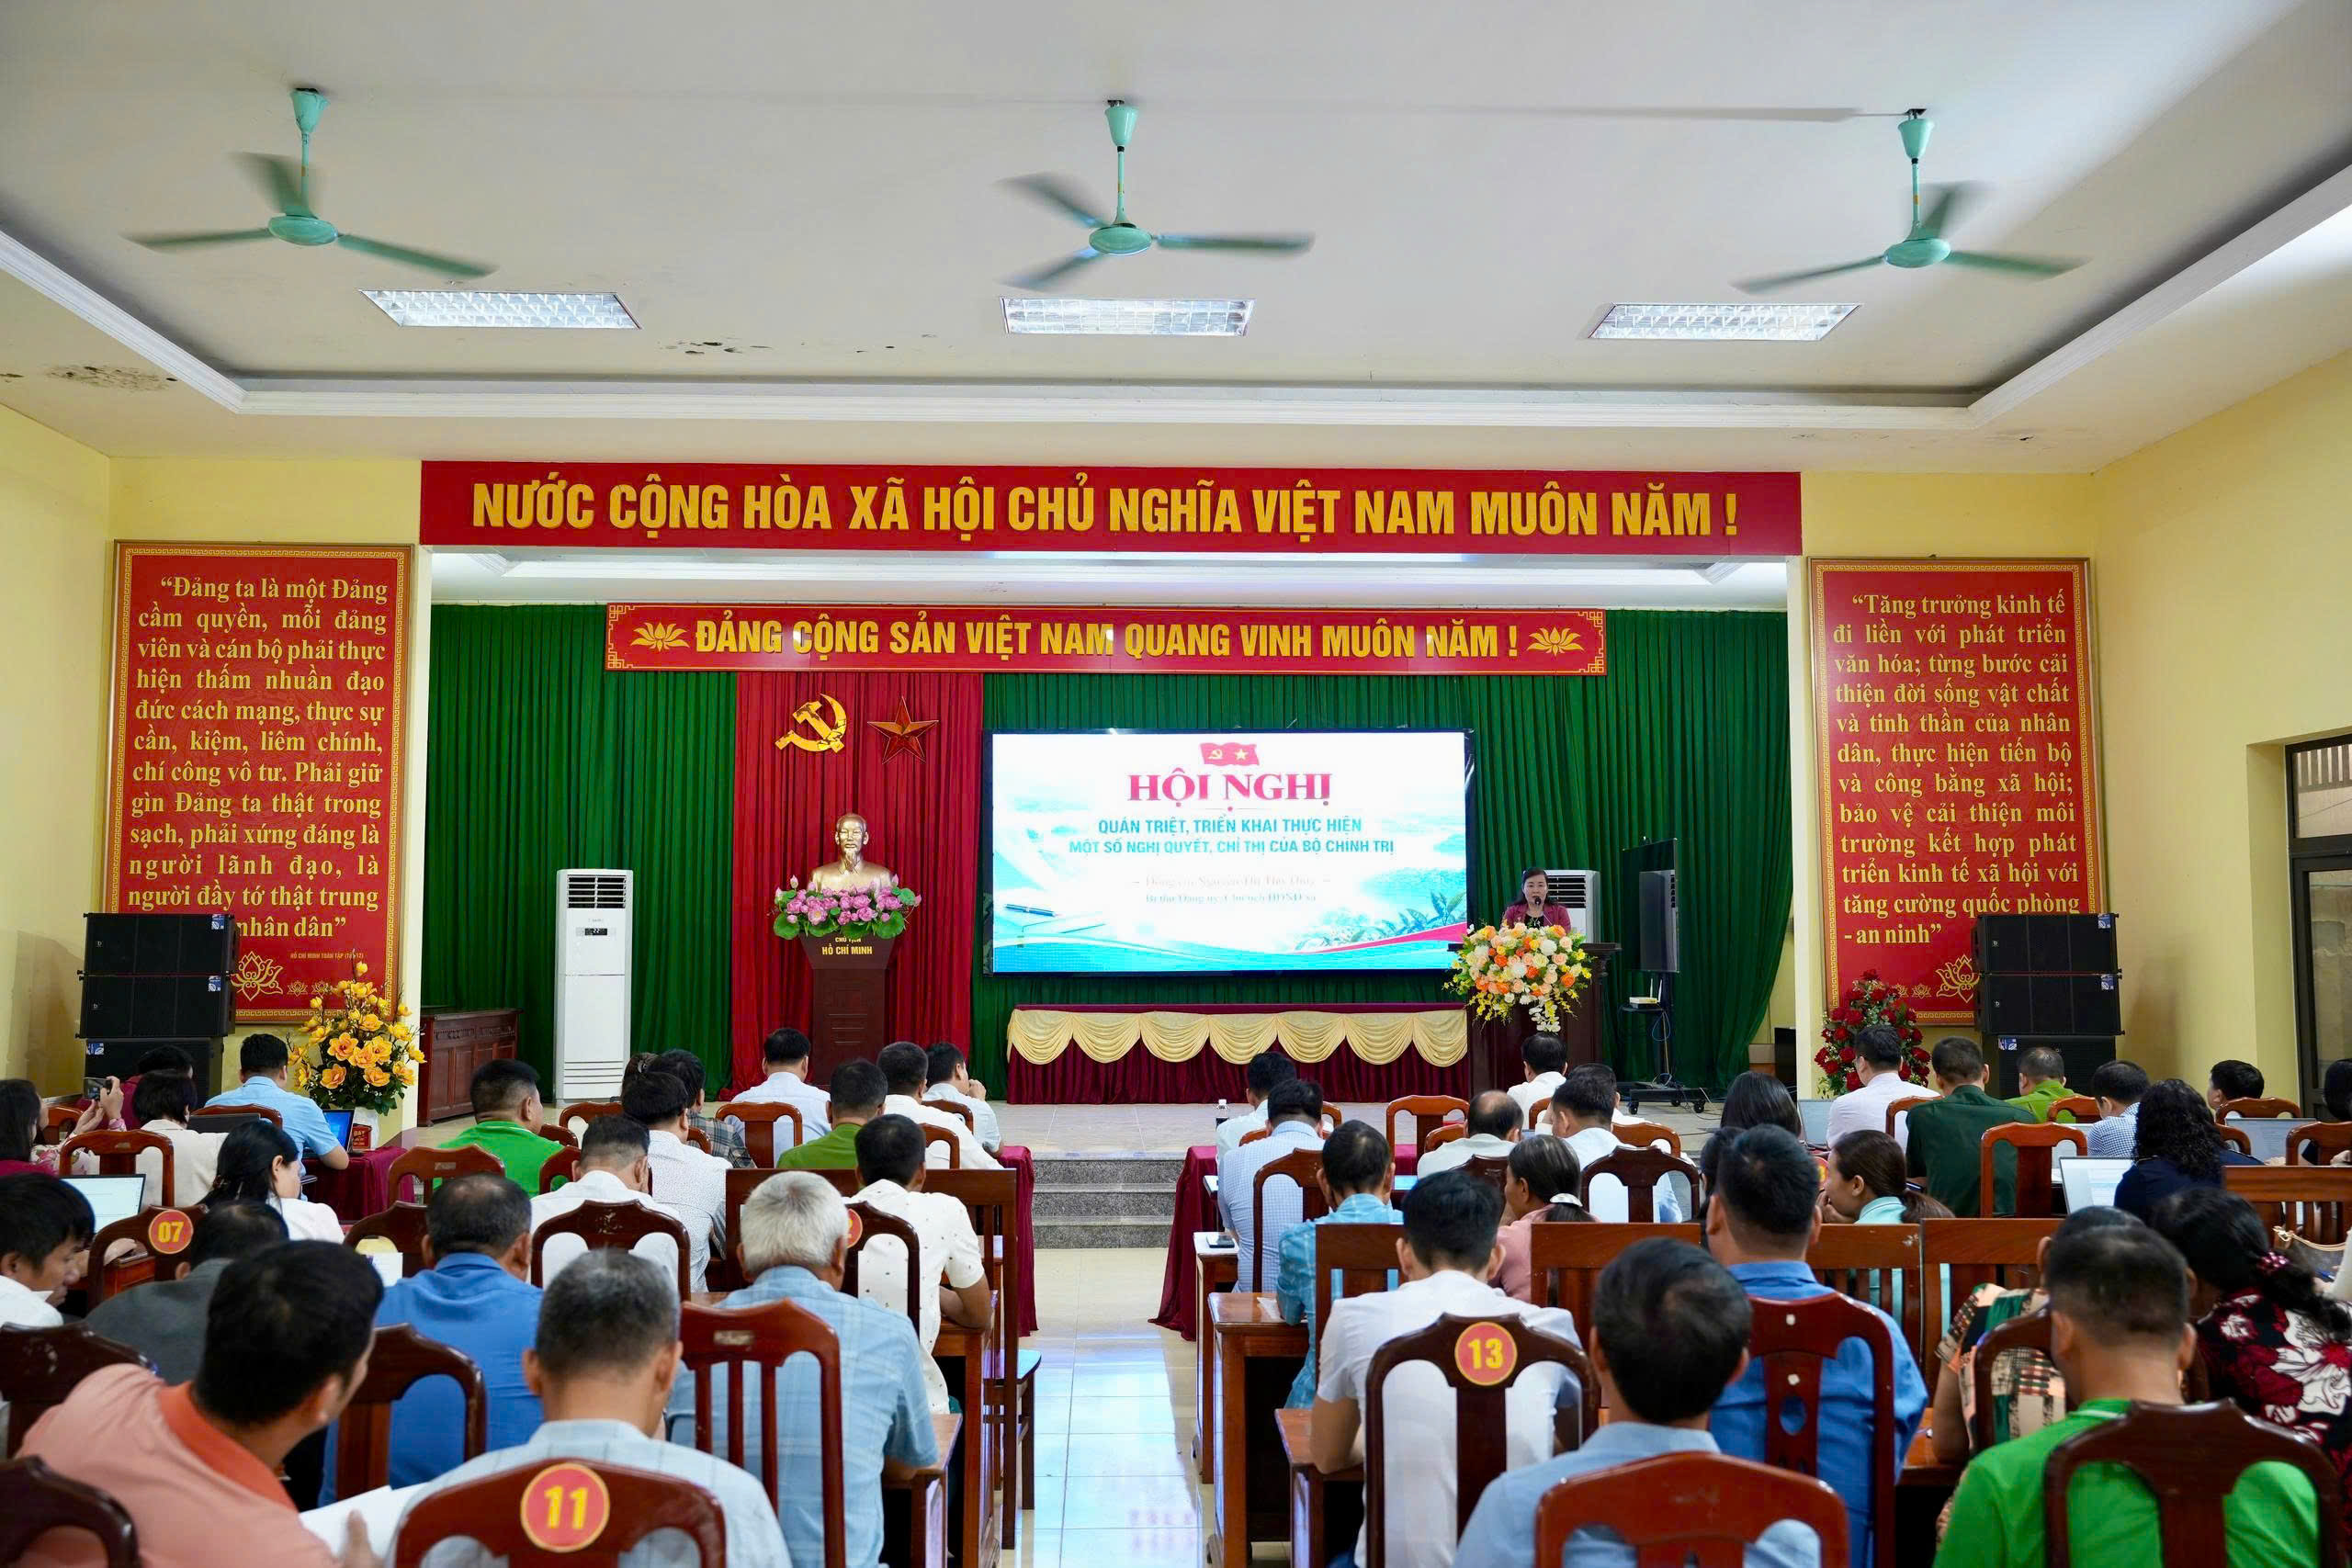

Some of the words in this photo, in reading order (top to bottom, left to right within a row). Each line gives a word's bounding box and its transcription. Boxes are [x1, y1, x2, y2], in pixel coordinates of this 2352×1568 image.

[473, 472, 594, 529] NƯỚC
[610, 474, 728, 537] CỘNG
[744, 474, 831, 529] HÒA
[850, 478, 909, 529] XÃ
[924, 477, 994, 541] HỘI
[1009, 472, 1093, 531] CHỦ
[1110, 479, 1241, 532] NGHĨA
[1252, 479, 1340, 542] VIỆT
[1355, 491, 1453, 534] NAM
[1471, 481, 1597, 535] MUÔN
[1612, 483, 1710, 536] NĂM
[1726, 494, 1736, 535] !
[162, 577, 229, 603] “Đảng
[235, 581, 254, 597] ta
[262, 578, 278, 597] là
[287, 579, 326, 604] một
[332, 580, 387, 604] Đảng
[1853, 595, 1916, 619] “Tăng
[1922, 595, 1991, 619] trưởng
[1997, 595, 2041, 613] kinh
[2048, 589, 2064, 614] tế
[139, 602, 182, 626] cầm
[197, 603, 267, 633] quyền,
[282, 604, 320, 628] mỗi
[334, 610, 386, 635] đảng
[1834, 625, 1852, 643] đi
[1865, 618, 1901, 643] liền
[1916, 625, 1946, 643] với
[1960, 625, 2005, 649] phát
[2018, 618, 2065, 642] triển
[695, 610, 783, 653] ĐẢNG
[793, 614, 878, 660] CỘNG
[888, 611, 956, 653] SẢN
[965, 615, 1031, 660] VIỆT
[1040, 623, 1115, 655] NAM
[1125, 626, 1228, 660] QUANG
[1240, 626, 1311, 656] VINH
[1323, 618, 1417, 658] MUÔN
[1427, 619, 1498, 659] NĂM
[1510, 626, 1517, 656] !
[139, 637, 180, 658] viên
[187, 638, 209, 658] và
[216, 638, 251, 658] cán
[257, 638, 282, 664] bộ
[288, 639, 334, 664] phải
[338, 640, 385, 665] thực
[1835, 654, 1870, 672] văn
[1878, 654, 1920, 676] hóa;
[1928, 654, 1975, 678] từng
[1983, 654, 2031, 672] bước
[2040, 654, 2067, 672] cải
[137, 668, 181, 694] hiện
[197, 663, 250, 689] thấm
[266, 664, 332, 690] nhuần
[346, 671, 384, 695] đạo
[1836, 682, 1885, 708] thiện
[1894, 683, 1926, 702] đời
[1934, 678, 1979, 706] sống
[1987, 682, 2018, 707] vật
[2027, 677, 2069, 702] chất
[136, 699, 175, 719] đức
[181, 700, 228, 719] cách
[236, 705, 300, 726] mạng,
[307, 701, 353, 726] thực
[360, 703, 385, 728] sự
[1837, 713, 1860, 732] và
[1870, 713, 1909, 732] tinh
[1920, 707, 1964, 732] thần
[1975, 713, 2009, 732] của
[2020, 713, 2070, 731] nhân
[134, 725, 176, 754] cần,
[190, 730, 248, 756] kiệm,
[261, 730, 305, 750] liêm
[318, 731, 382, 756] chính,
[1838, 742, 1881, 767] dân,
[1891, 742, 1936, 768] thực
[1947, 742, 1988, 768] hiện
[1999, 737, 2036, 761] tiến
[2048, 742, 2071, 767] bộ
[133, 761, 164, 781] chí
[172, 761, 220, 786] công
[228, 761, 252, 781] vô
[258, 763, 287, 782] tư.
[294, 761, 341, 782] Phải
[348, 762, 382, 786] giữ
[1127, 767, 1210, 807] HỘI
[1223, 773, 1332, 806] NGHỊ
[1838, 773, 1862, 793] và
[1874, 772, 1922, 797] công
[1935, 767, 1984, 797] bằng
[1998, 773, 2021, 792] xã
[2034, 773, 2072, 796] hội;
[132, 792, 164, 818] gìn
[175, 792, 232, 818] Đảng
[242, 794, 261, 813] ta
[272, 792, 314, 818] thật
[324, 795, 381, 818] trong
[1839, 803, 1877, 823] bảo
[1890, 803, 1913, 828] vệ
[1927, 803, 1956, 822] cải
[1970, 803, 2021, 827] thiện
[2037, 803, 2074, 821] môi
[131, 823, 183, 849] sạch,
[190, 823, 237, 849] phải
[243, 823, 297, 849] xứng
[303, 824, 356, 850] đáng
[361, 824, 379, 844] là
[1841, 833, 1915, 858] trường
[1928, 827, 1961, 852] kết
[1975, 833, 2014, 857] hợp
[2029, 832, 2075, 857] phát
[130, 854, 201, 880] người
[219, 854, 272, 874] lãnh
[289, 855, 341, 880] đạo,
[358, 855, 379, 874] là
[1842, 857, 1890, 883] triển
[1898, 863, 1943, 882] kinh
[1951, 857, 1969, 882] tế
[1977, 863, 1999, 882] xã
[2008, 863, 2039, 887] hội
[2047, 863, 2077, 882] với
[129, 886, 189, 911] người
[198, 879, 235, 910] đầy
[243, 886, 265, 905] tớ
[270, 885, 313, 911] thật
[320, 887, 379, 911] trung
[1844, 895, 1888, 919] tăng
[1894, 894, 1956, 918] cường
[1962, 887, 2009, 918] quốc
[2018, 893, 2079, 914] phòng
[294, 916, 345, 936] dân”
[1857, 930, 1880, 943] an
[1885, 924, 1941, 943] ninh”
[822, 942, 833, 955] HỒ
[836, 943, 849, 955] CHÍ
[851, 946, 873, 955] MINH
[158, 1221, 185, 1243] 07
[1467, 1337, 1504, 1370] 13
[544, 1484, 589, 1530] 11
